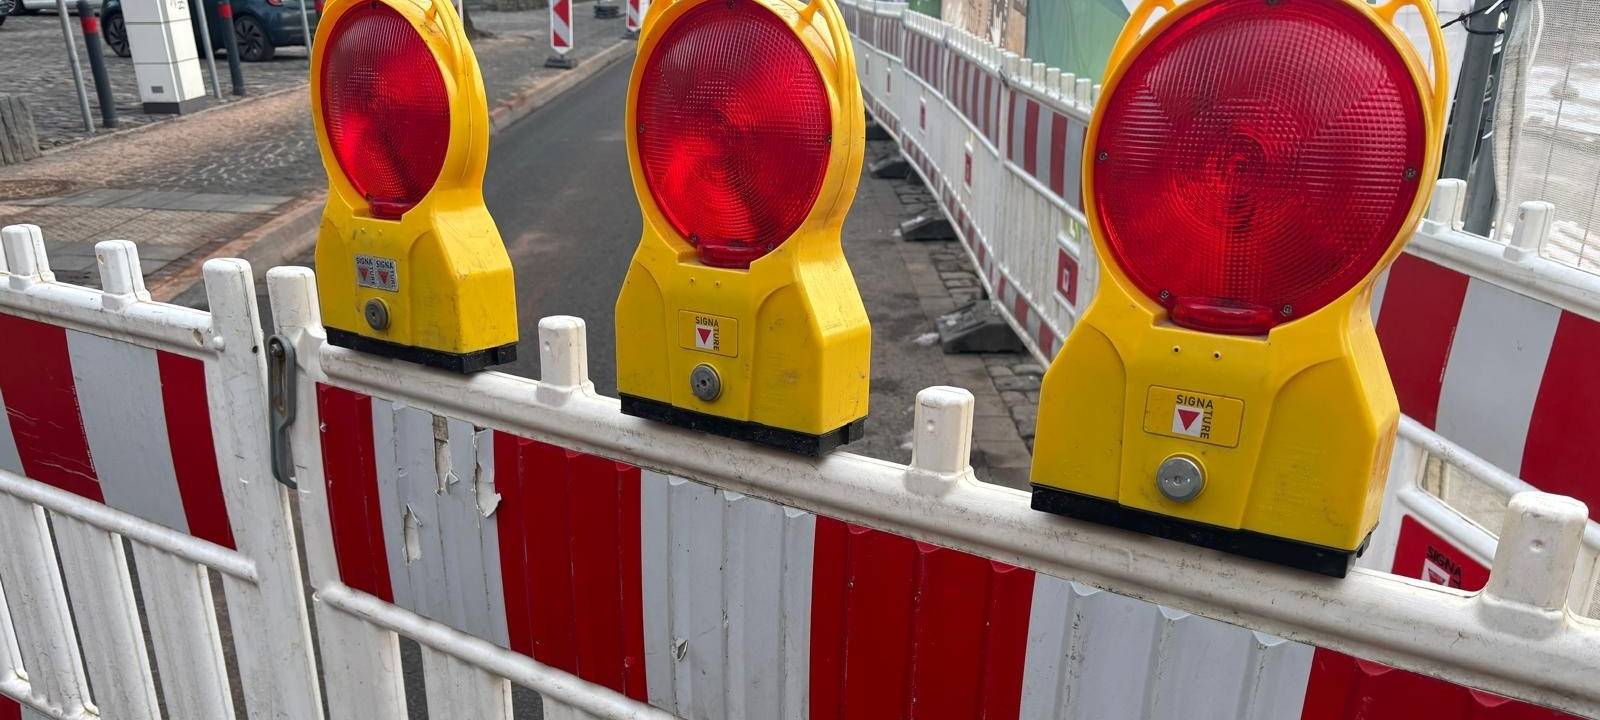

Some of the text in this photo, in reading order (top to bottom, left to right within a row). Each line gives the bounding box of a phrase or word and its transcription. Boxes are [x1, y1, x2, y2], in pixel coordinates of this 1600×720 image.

[376, 260, 394, 269] SIGNA
[695, 316, 719, 328] SIGNA
[1176, 394, 1214, 410] SIGNA
[1200, 410, 1213, 439] TURE
[1426, 546, 1462, 576] SIGNA
